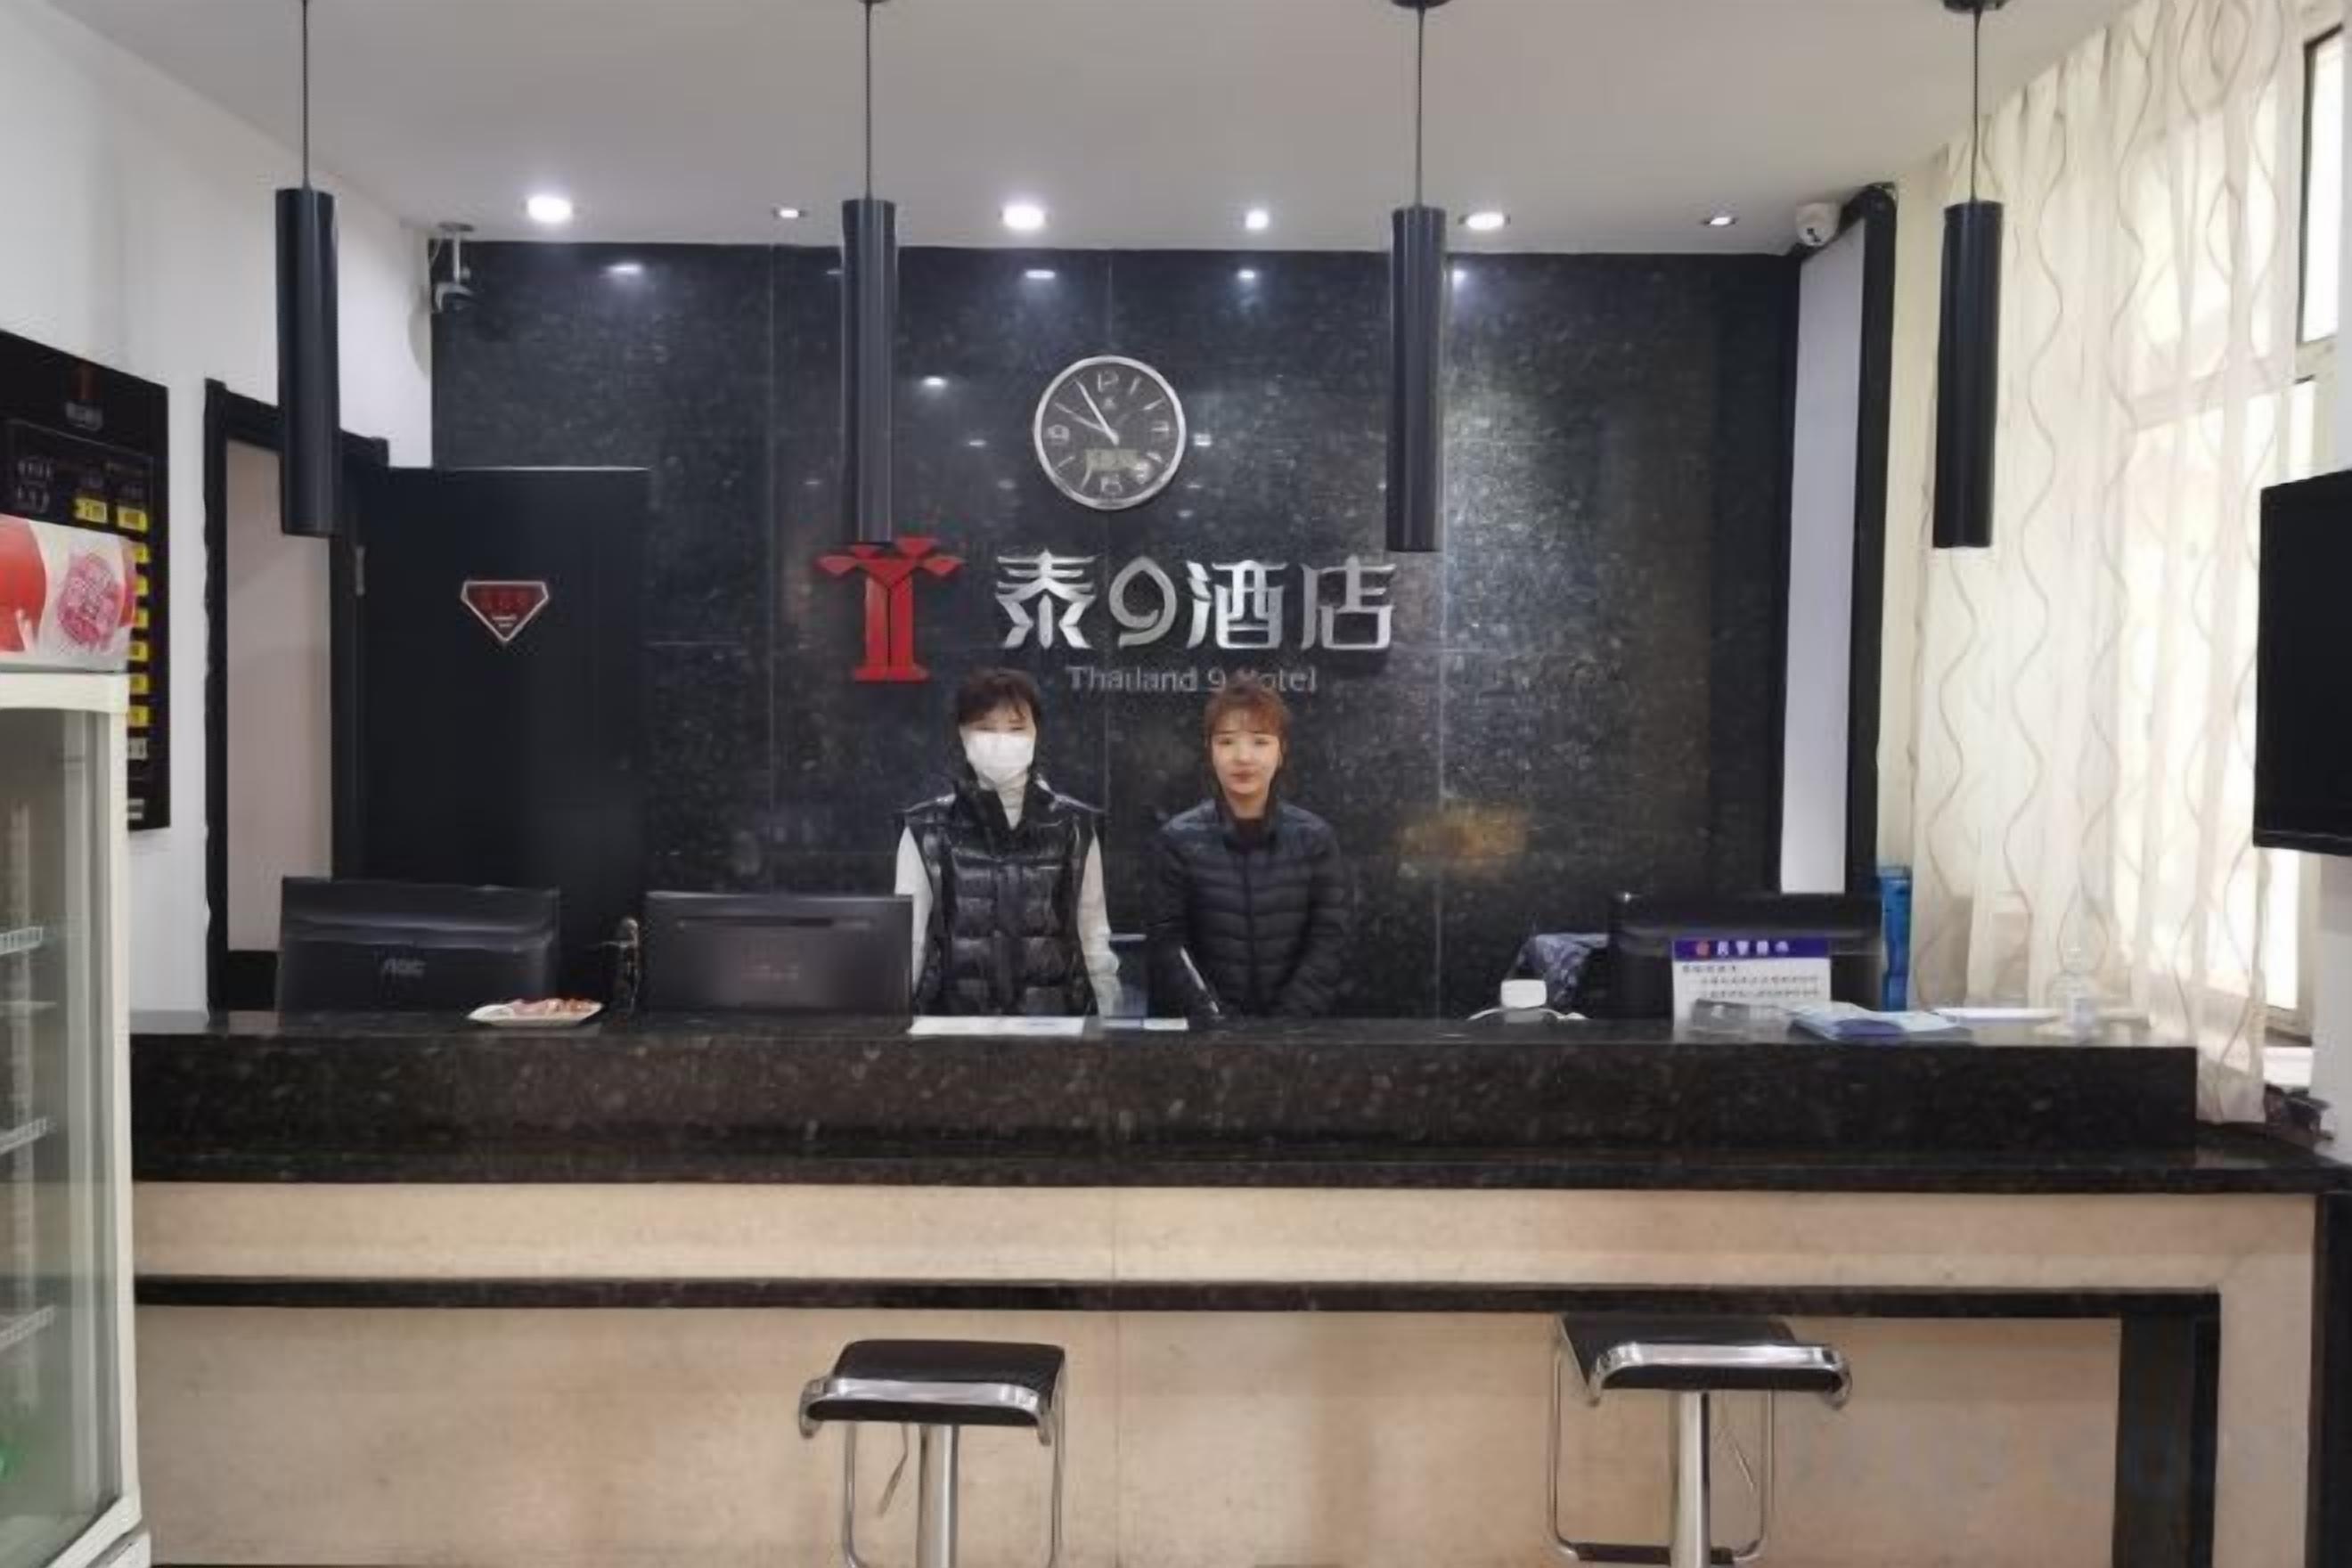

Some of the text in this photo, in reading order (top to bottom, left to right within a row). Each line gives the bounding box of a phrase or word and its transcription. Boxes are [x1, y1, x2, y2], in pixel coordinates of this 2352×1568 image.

[995, 549, 1397, 649] 泰9酒店
[1065, 665, 1197, 693] Thailand
[1206, 666, 1227, 693] 9
